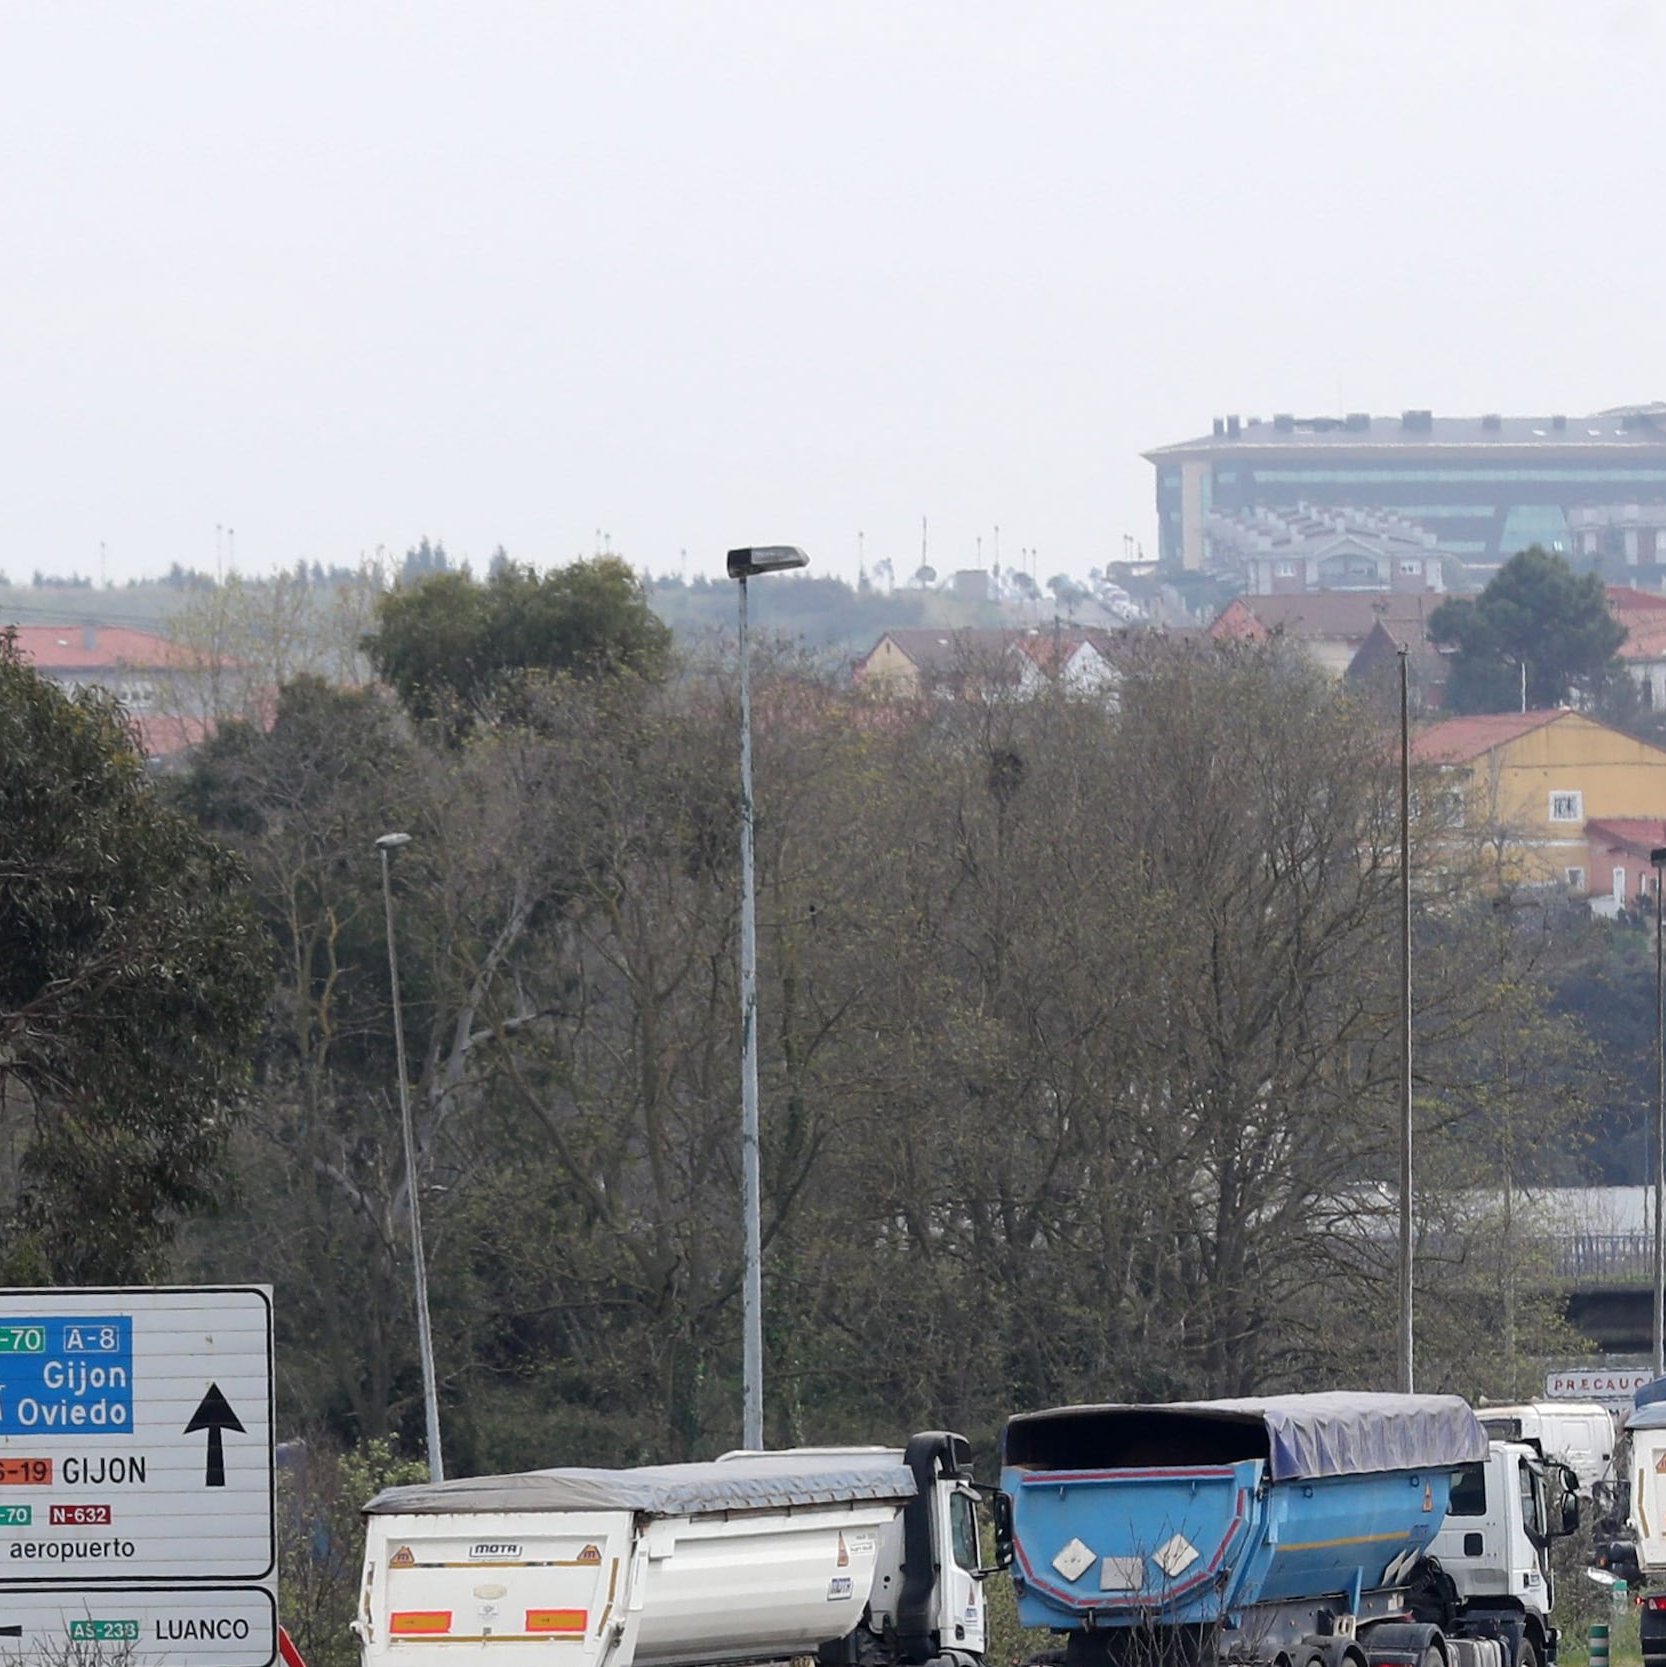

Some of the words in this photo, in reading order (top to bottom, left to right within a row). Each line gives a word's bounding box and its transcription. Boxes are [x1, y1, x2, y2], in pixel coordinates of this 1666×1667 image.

[67, 1328, 115, 1349] A-8
[43, 1361, 127, 1396] Gijon
[18, 1398, 127, 1426] Oviedo
[63, 1456, 146, 1484] GIJON
[53, 1508, 106, 1523] N-632
[10, 1538, 135, 1562] aeropuerto
[155, 1619, 250, 1640] LUANCO
